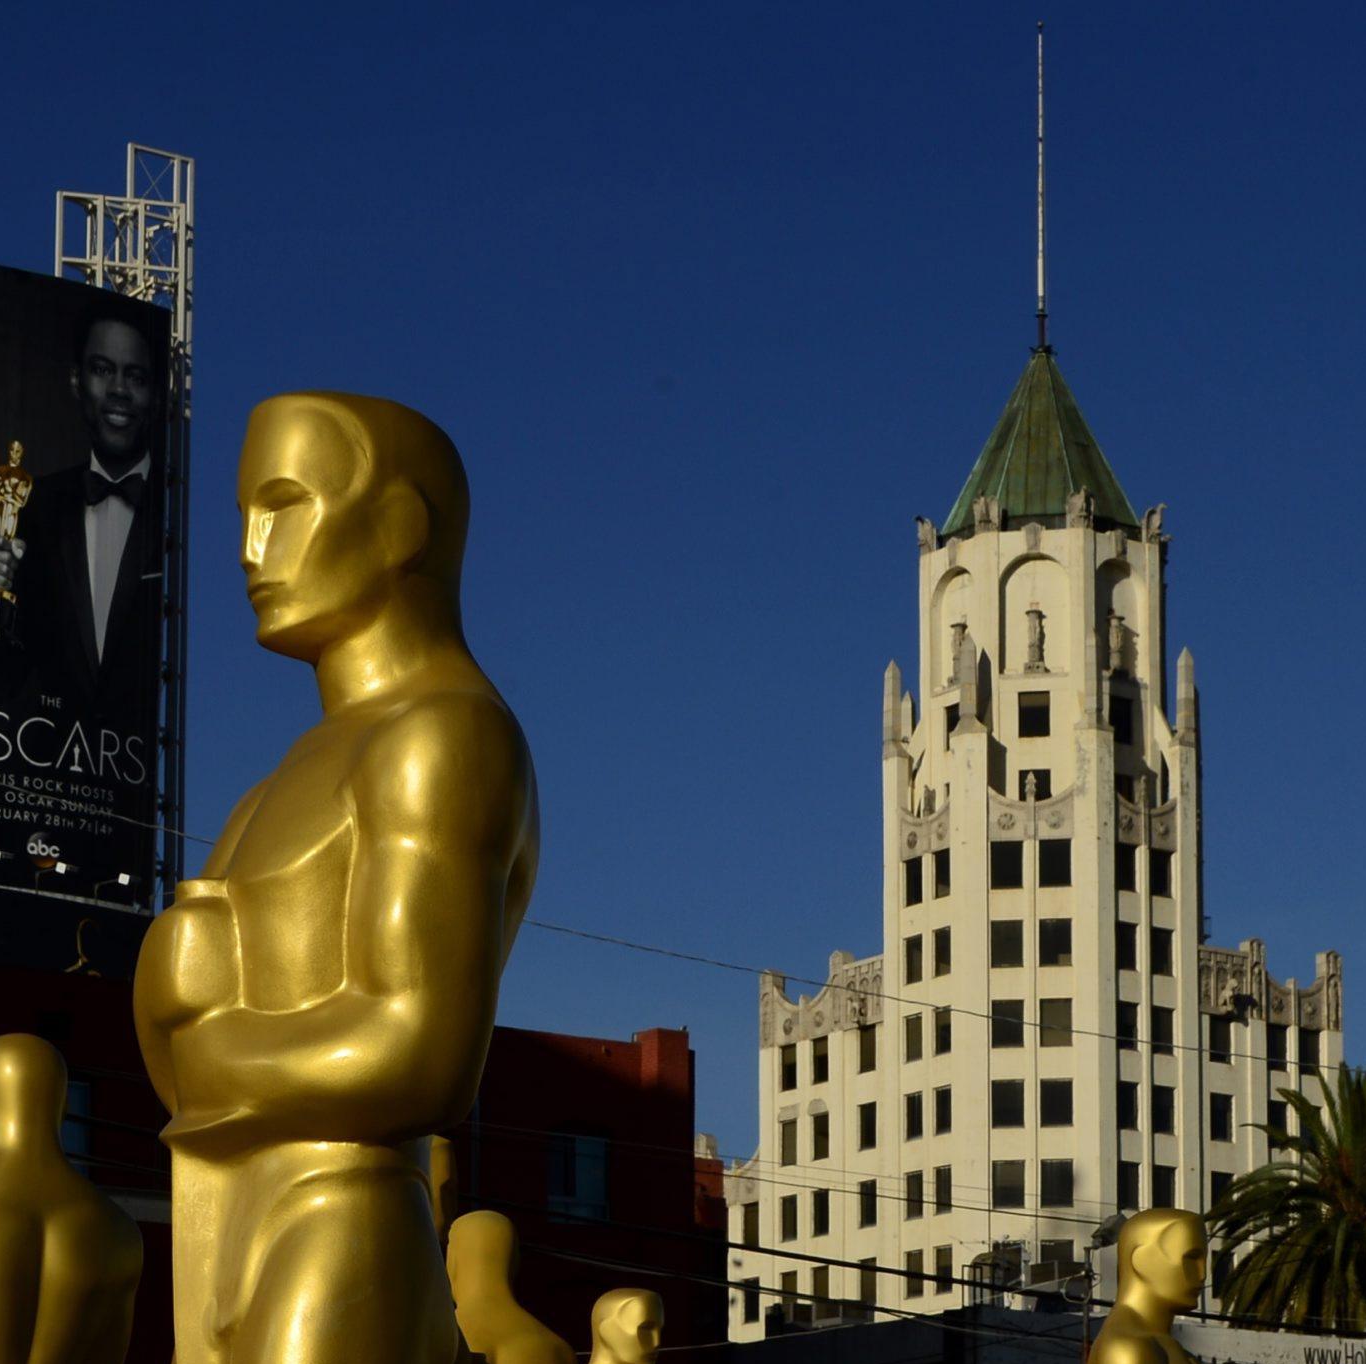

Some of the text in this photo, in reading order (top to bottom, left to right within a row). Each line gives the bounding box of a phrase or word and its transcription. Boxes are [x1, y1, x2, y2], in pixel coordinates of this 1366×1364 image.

[40, 695, 64, 709] THE
[23, 777, 65, 793] ROCK
[70, 783, 115, 802] HOSTS
[4, 790, 55, 810] OSCAR
[60, 798, 114, 819] SUNDAY
[26, 839, 61, 858] abc
